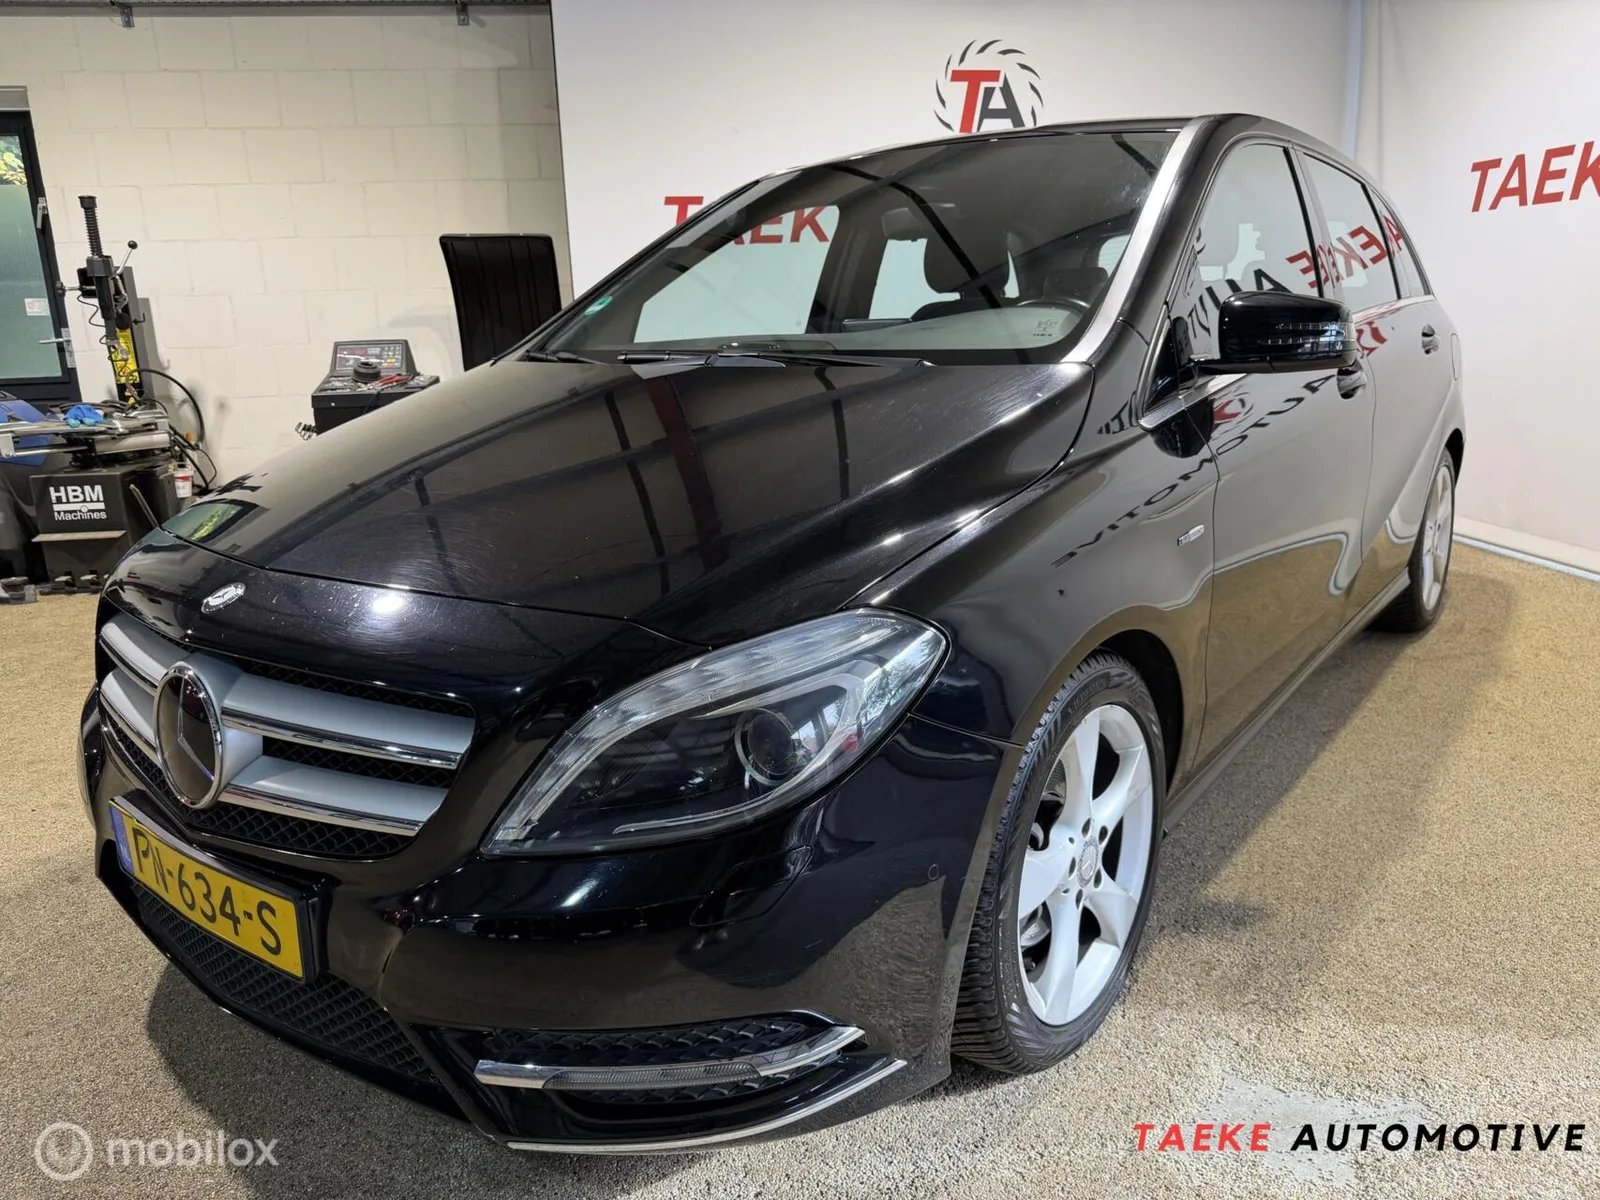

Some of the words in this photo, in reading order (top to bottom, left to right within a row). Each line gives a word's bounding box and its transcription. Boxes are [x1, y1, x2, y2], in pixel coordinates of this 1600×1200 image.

[950, 70, 1025, 133] TA
[664, 196, 829, 245] TEK
[49, 485, 104, 503] HBM
[54, 511, 107, 521] Machines
[132, 827, 281, 955] PN-634-S
